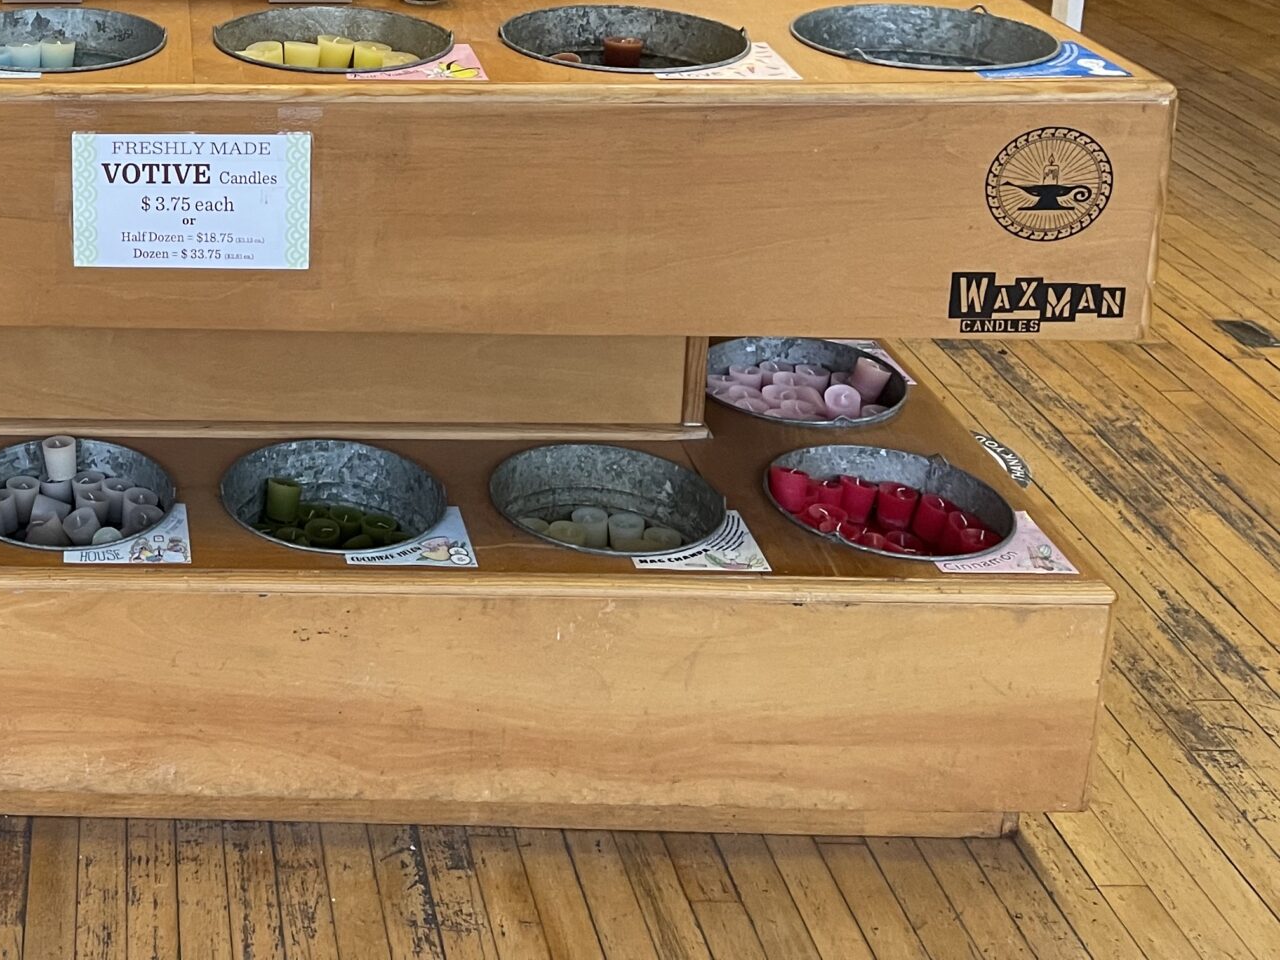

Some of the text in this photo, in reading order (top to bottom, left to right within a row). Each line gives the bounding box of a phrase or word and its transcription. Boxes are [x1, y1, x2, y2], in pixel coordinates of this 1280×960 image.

[111, 141, 271, 155] FRESHLY MADE
[101, 163, 278, 185] VOTIVE Candles
[141, 195, 235, 213] $ 3.75 each
[182, 216, 197, 226] or
[121, 231, 147, 243] Half
[148, 231, 185, 243] Dozen
[196, 232, 234, 243] $18.75
[133, 248, 169, 259] Dozen
[181, 248, 187, 260] $
[191, 249, 221, 260] 33.75
[956, 275, 1123, 319] WAXMAN
[961, 320, 1039, 332] CANDLES
[975, 436, 1005, 452] YOU
[80, 549, 125, 562] HOUSE
[943, 550, 1019, 571] Cinnamon
